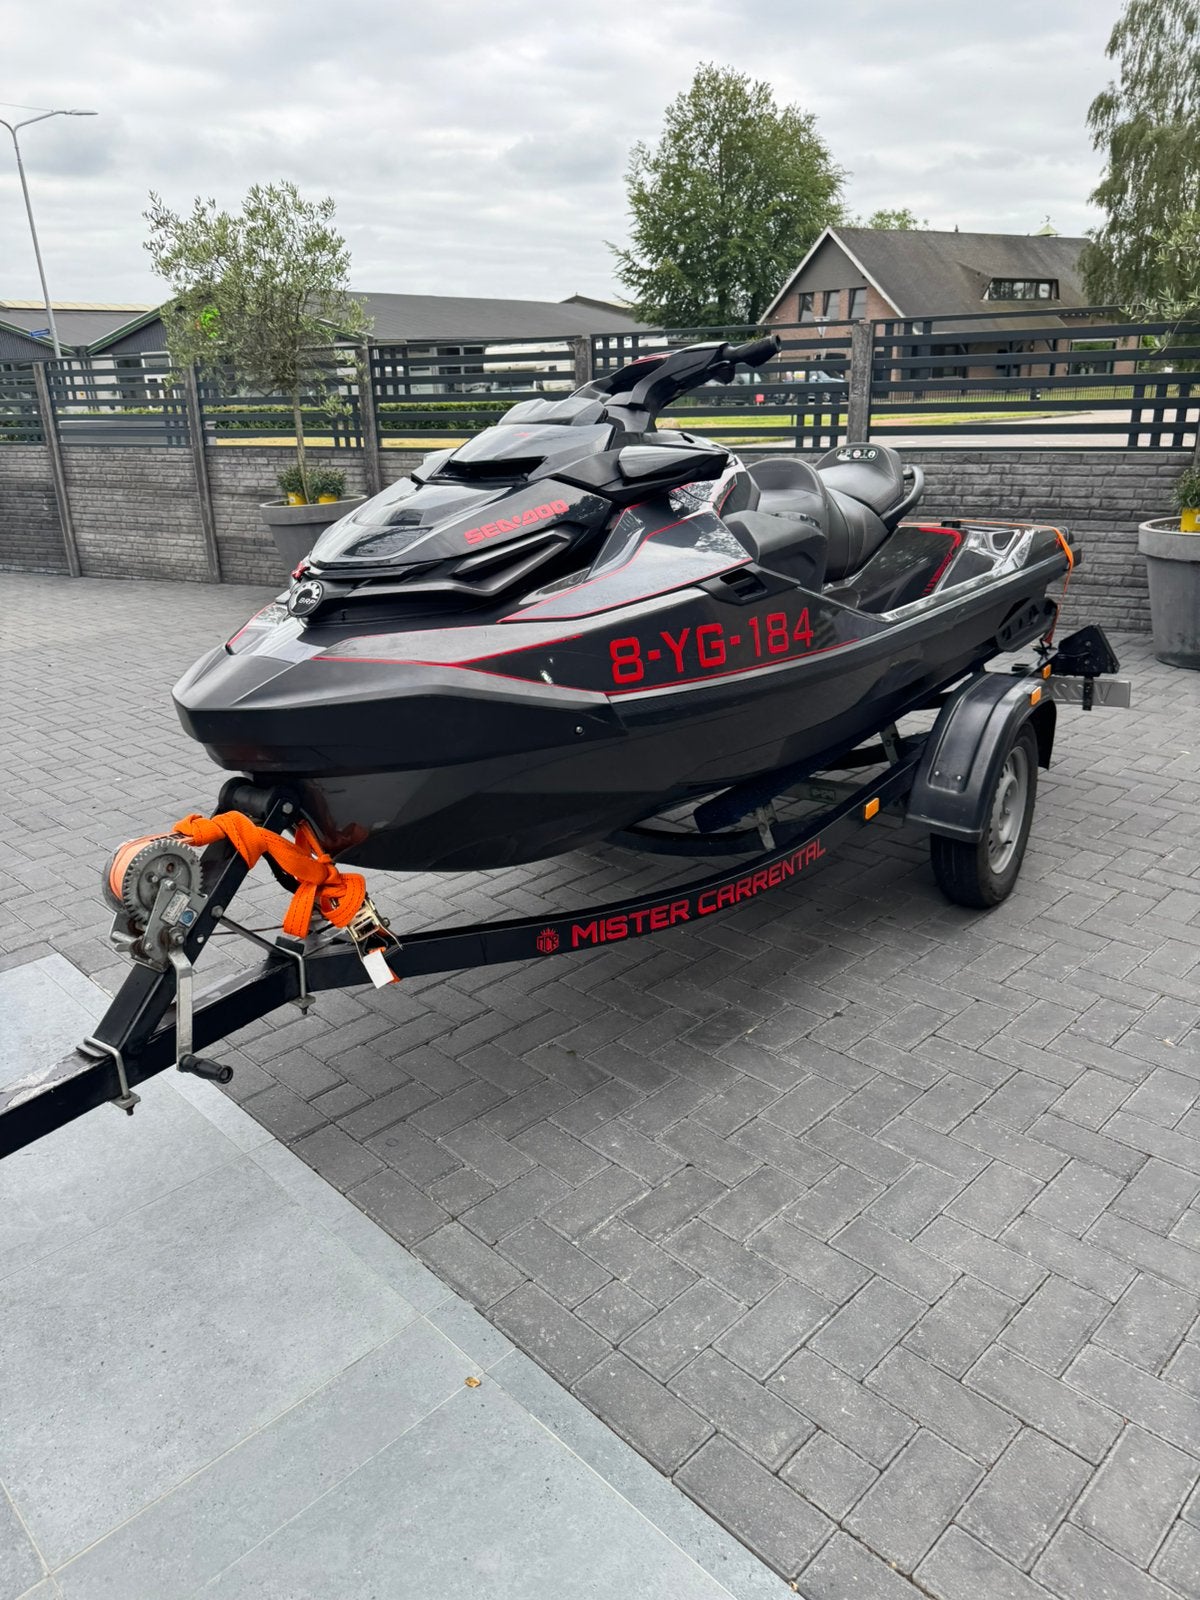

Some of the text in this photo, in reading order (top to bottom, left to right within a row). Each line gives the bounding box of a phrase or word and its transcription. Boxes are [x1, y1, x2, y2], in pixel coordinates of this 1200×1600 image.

[298, 597, 317, 605] BRP
[609, 607, 815, 684] 8-YG-184
[571, 838, 827, 948] MISTER CARRENTAL
